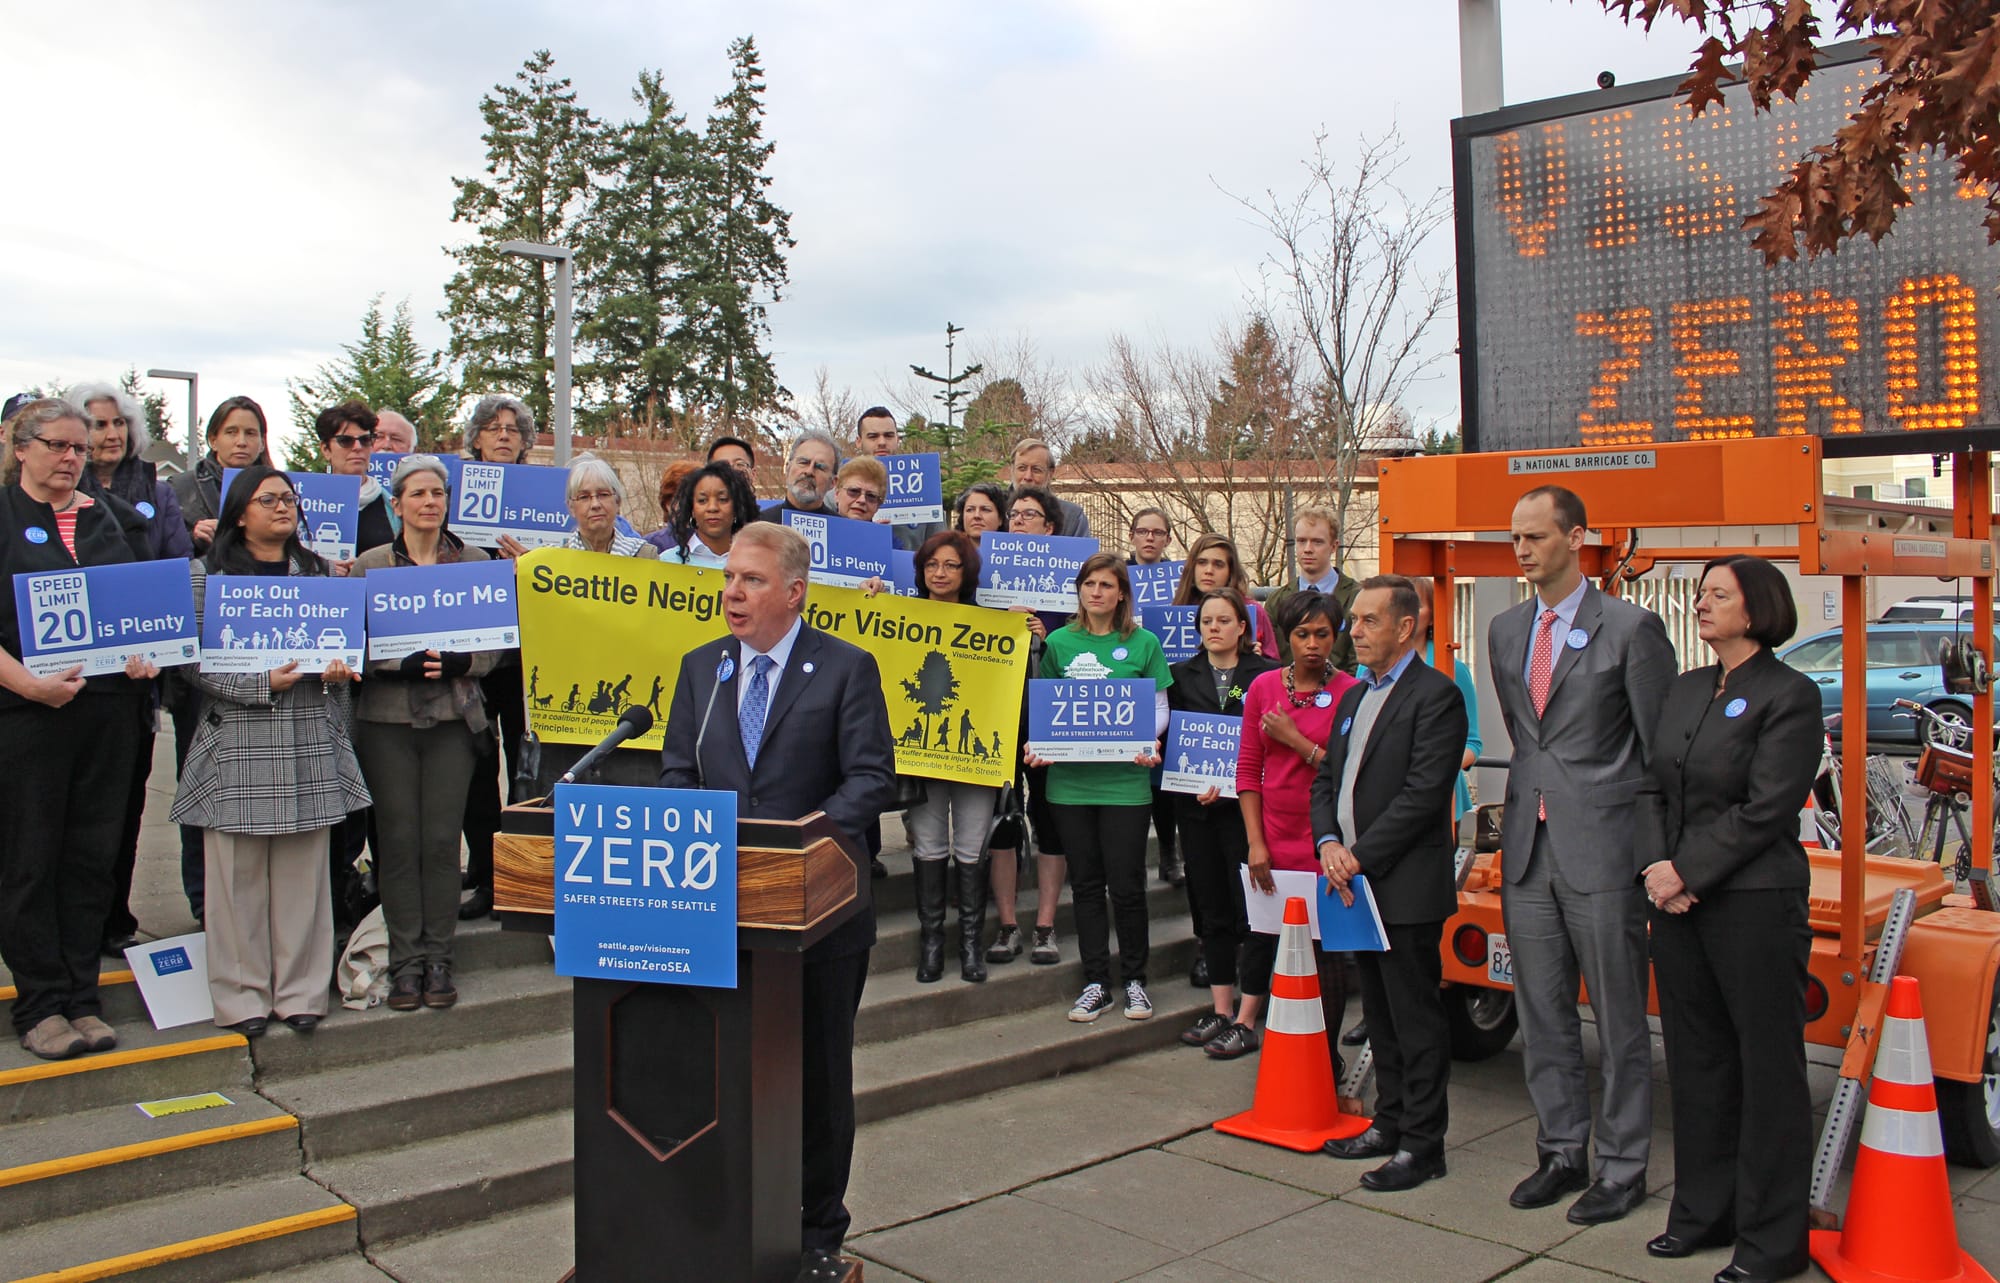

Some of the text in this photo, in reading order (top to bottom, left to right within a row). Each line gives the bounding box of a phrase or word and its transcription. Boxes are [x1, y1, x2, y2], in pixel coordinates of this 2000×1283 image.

[1574, 273, 1980, 447] ZERO
[888, 459, 920, 472] ION
[1526, 454, 1650, 470] NATIONAL BARRICADE CO.
[465, 467, 501, 479] SPEED
[468, 479, 498, 490] LIMIT
[889, 472, 924, 495] RØ
[302, 498, 345, 514] Other
[462, 492, 570, 528] 20 is Plenty
[793, 516, 825, 529] SPEED
[801, 528, 823, 539] IMIT
[991, 538, 1050, 554] Look Out
[810, 541, 887, 576] 0 is Plenty
[990, 553, 1083, 570] for Each Other
[1135, 565, 1184, 580] VISIO
[33, 577, 82, 593] SPEED
[220, 584, 300, 600] Look Out
[39, 592, 80, 608] LIMIT
[373, 584, 508, 614] Stop for Me
[219, 603, 349, 618] for Each Other
[532, 564, 638, 605] Seattle
[807, 603, 846, 632] for
[855, 609, 942, 646] Vision
[950, 623, 1016, 655] Zero
[1164, 611, 1196, 623] VIS
[39, 609, 185, 645] 20 is Plenty
[1162, 626, 1196, 649] ZE
[951, 650, 1014, 667] VisionZeroSea.org
[1054, 684, 1131, 698] VISION
[548, 714, 581, 722] coalition
[582, 716, 590, 724] of
[590, 718, 616, 726] people
[1180, 719, 1242, 736] Look Out
[533, 723, 577, 734] Principles:
[578, 727, 593, 735] Life
[1179, 734, 1235, 751] for Each
[902, 749, 922, 757] suffer
[924, 752, 949, 760] serious
[950, 755, 971, 764] injury
[896, 758, 1002, 777] Responsible for Safe Streets
[569, 803, 713, 834] VISION
[563, 893, 717, 912] SAFER STREETS FOR SEATTLE
[598, 941, 690, 955] seattle.gov/visionzero
[598, 957, 691, 974] #VisionZeroSEA
[1493, 952, 1513, 976] 82
